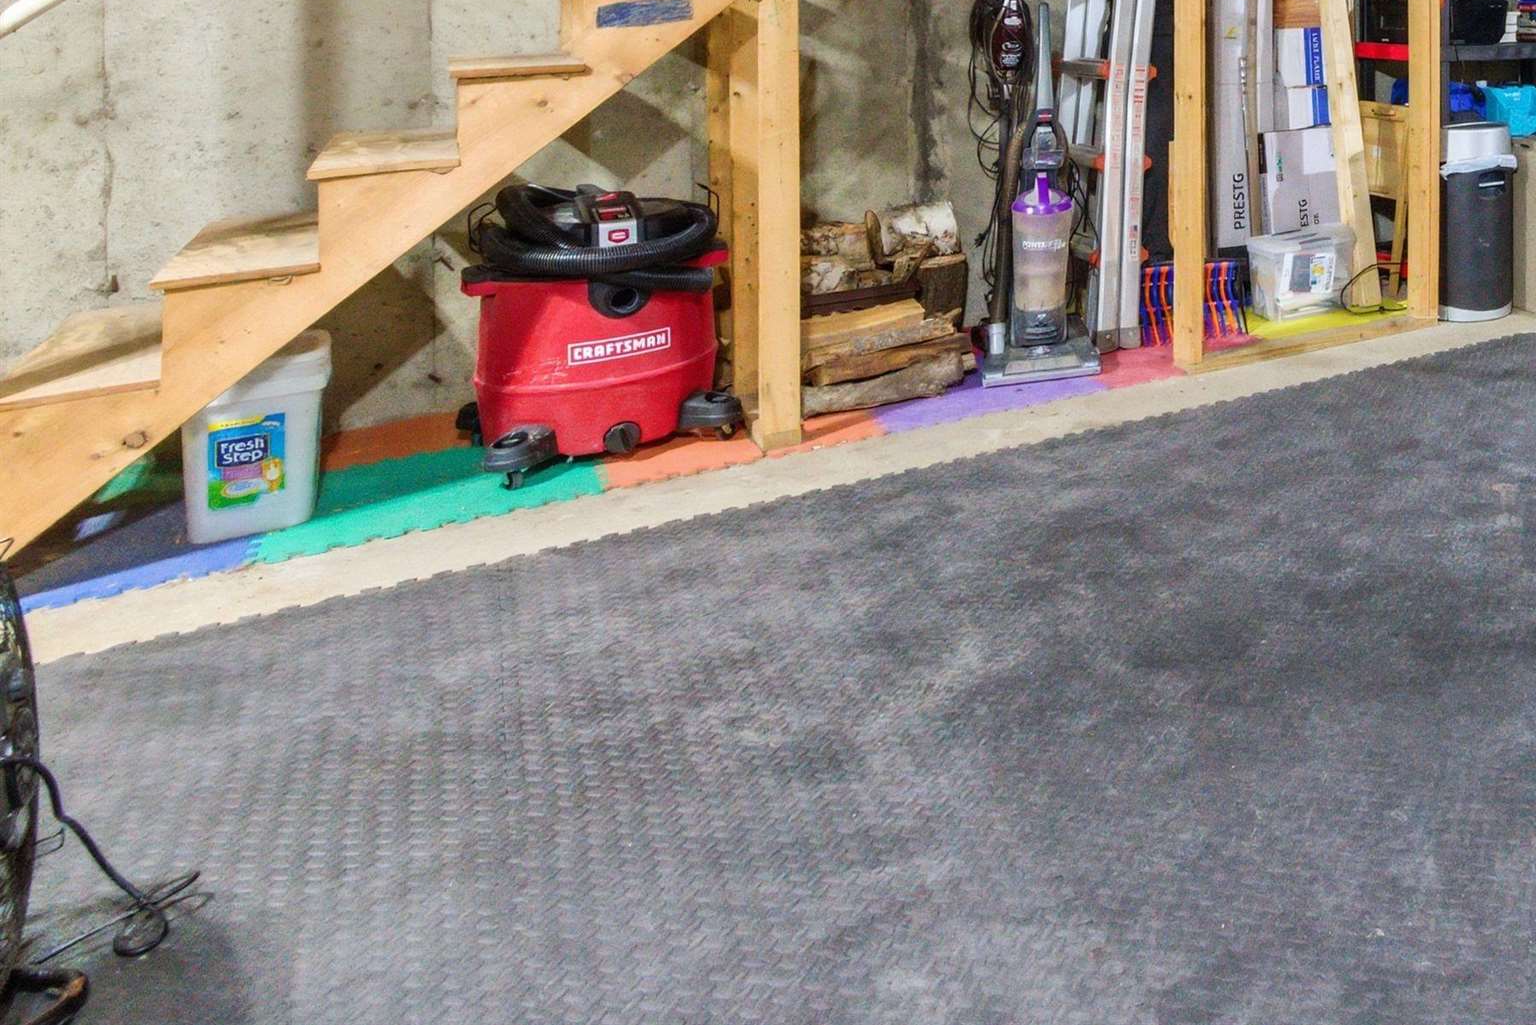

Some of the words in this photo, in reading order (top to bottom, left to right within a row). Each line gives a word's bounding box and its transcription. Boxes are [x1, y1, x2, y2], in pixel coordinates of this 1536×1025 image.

[1233, 173, 1246, 230] PRESTG
[573, 333, 666, 361] CRAFTSMAN
[221, 438, 265, 454] Fresh
[222, 450, 263, 465] Step
